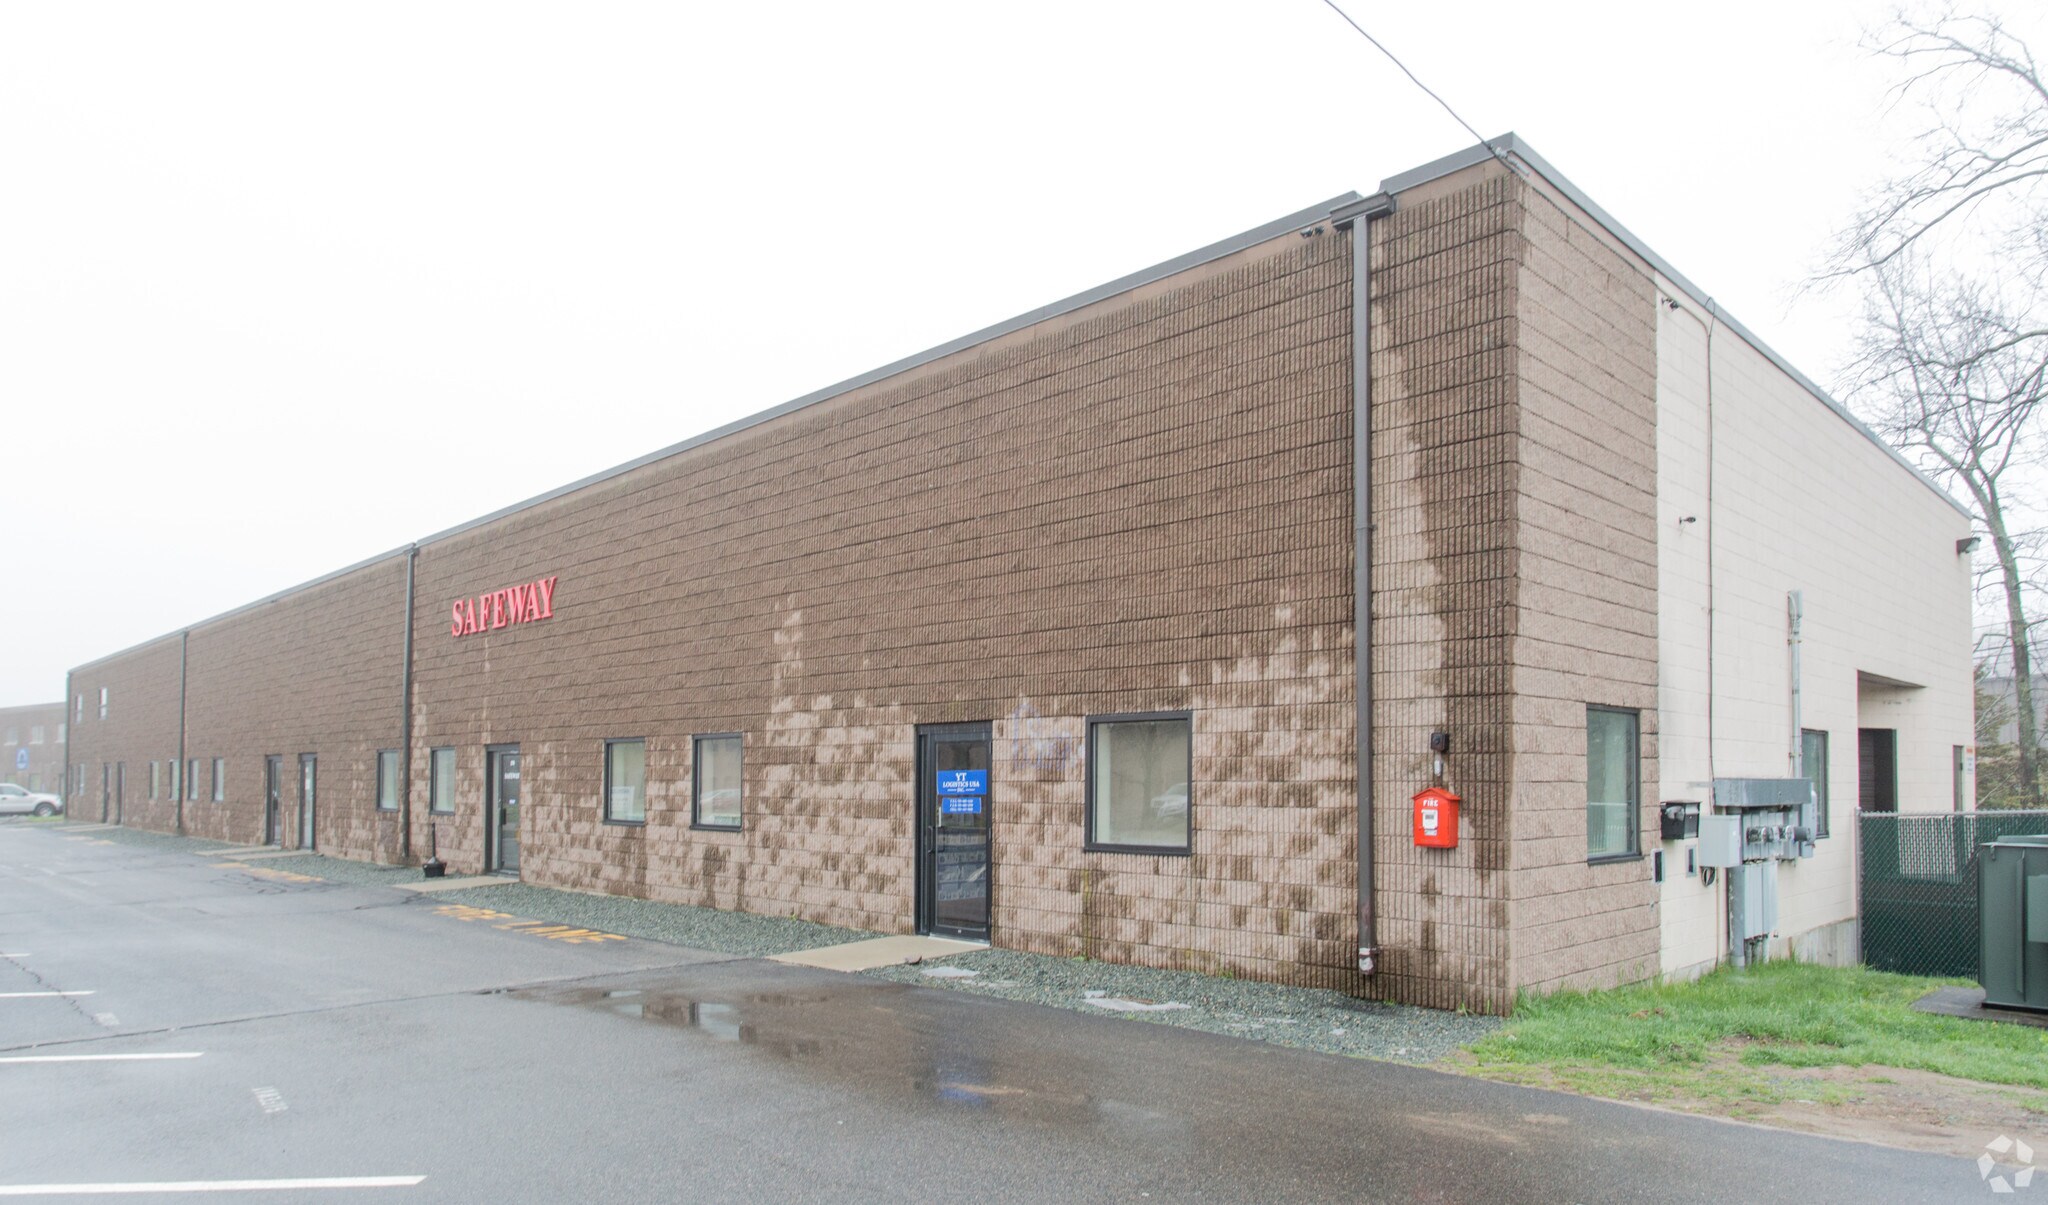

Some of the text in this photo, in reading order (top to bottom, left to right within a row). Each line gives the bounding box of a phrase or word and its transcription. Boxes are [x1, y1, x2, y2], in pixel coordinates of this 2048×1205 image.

[451, 575, 557, 637] SAFEWAY
[955, 772, 967, 781] YT
[942, 780, 980, 788] LOGISTICS USA
[1423, 799, 1439, 807] FIRE
